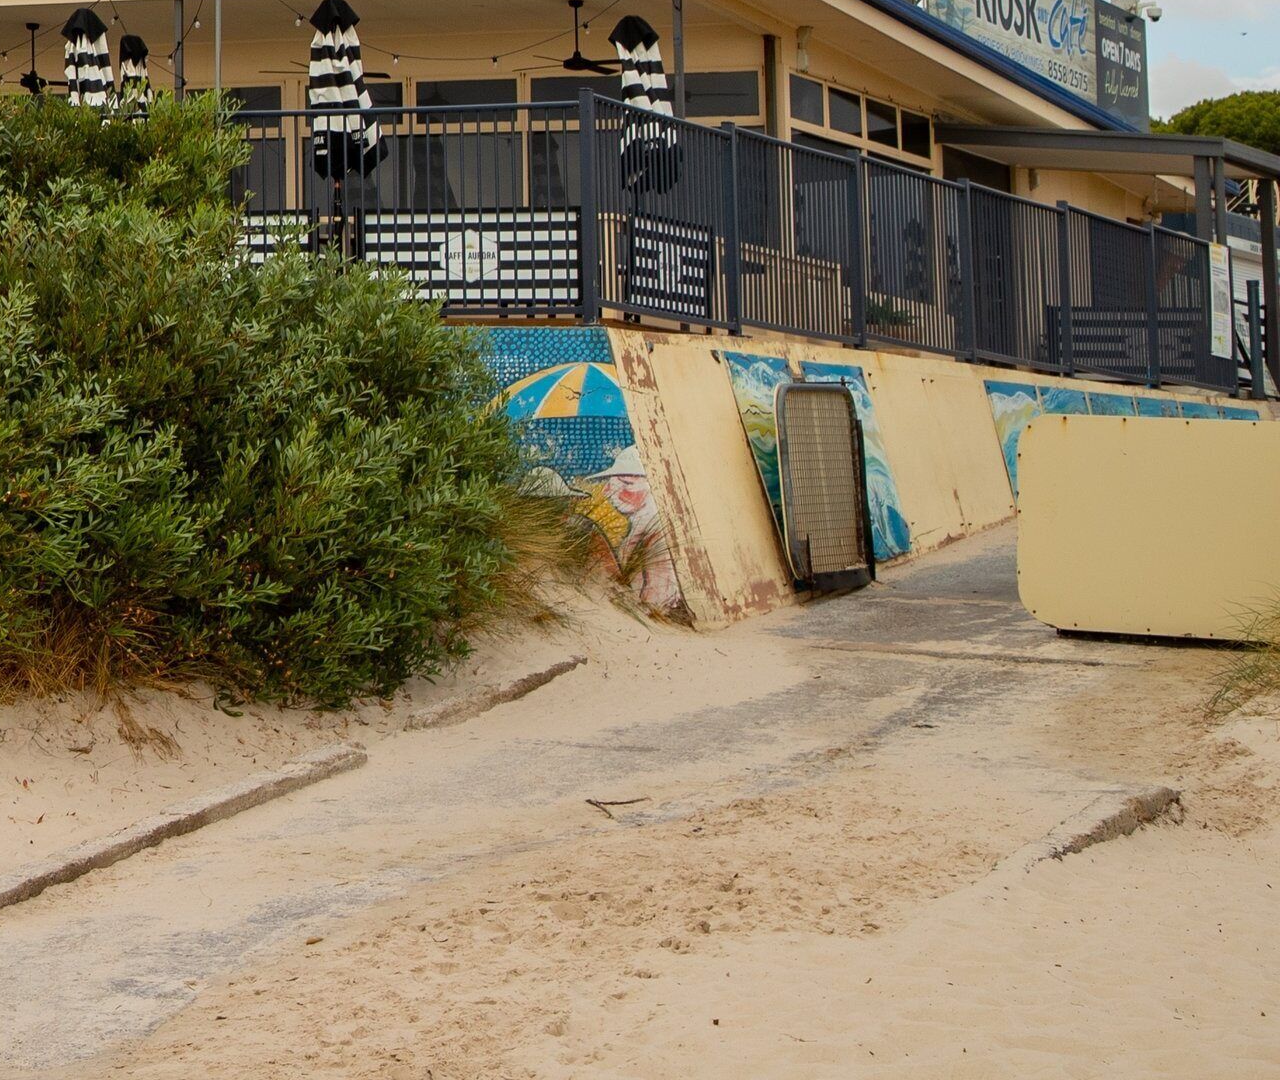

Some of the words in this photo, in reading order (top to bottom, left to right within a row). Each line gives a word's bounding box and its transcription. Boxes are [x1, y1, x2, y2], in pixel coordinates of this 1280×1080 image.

[1101, 37, 1120, 64] OPEN
[1119, 41, 1125, 65] 7
[1124, 47, 1142, 73] DAYS
[445, 251, 465, 260] AFF
